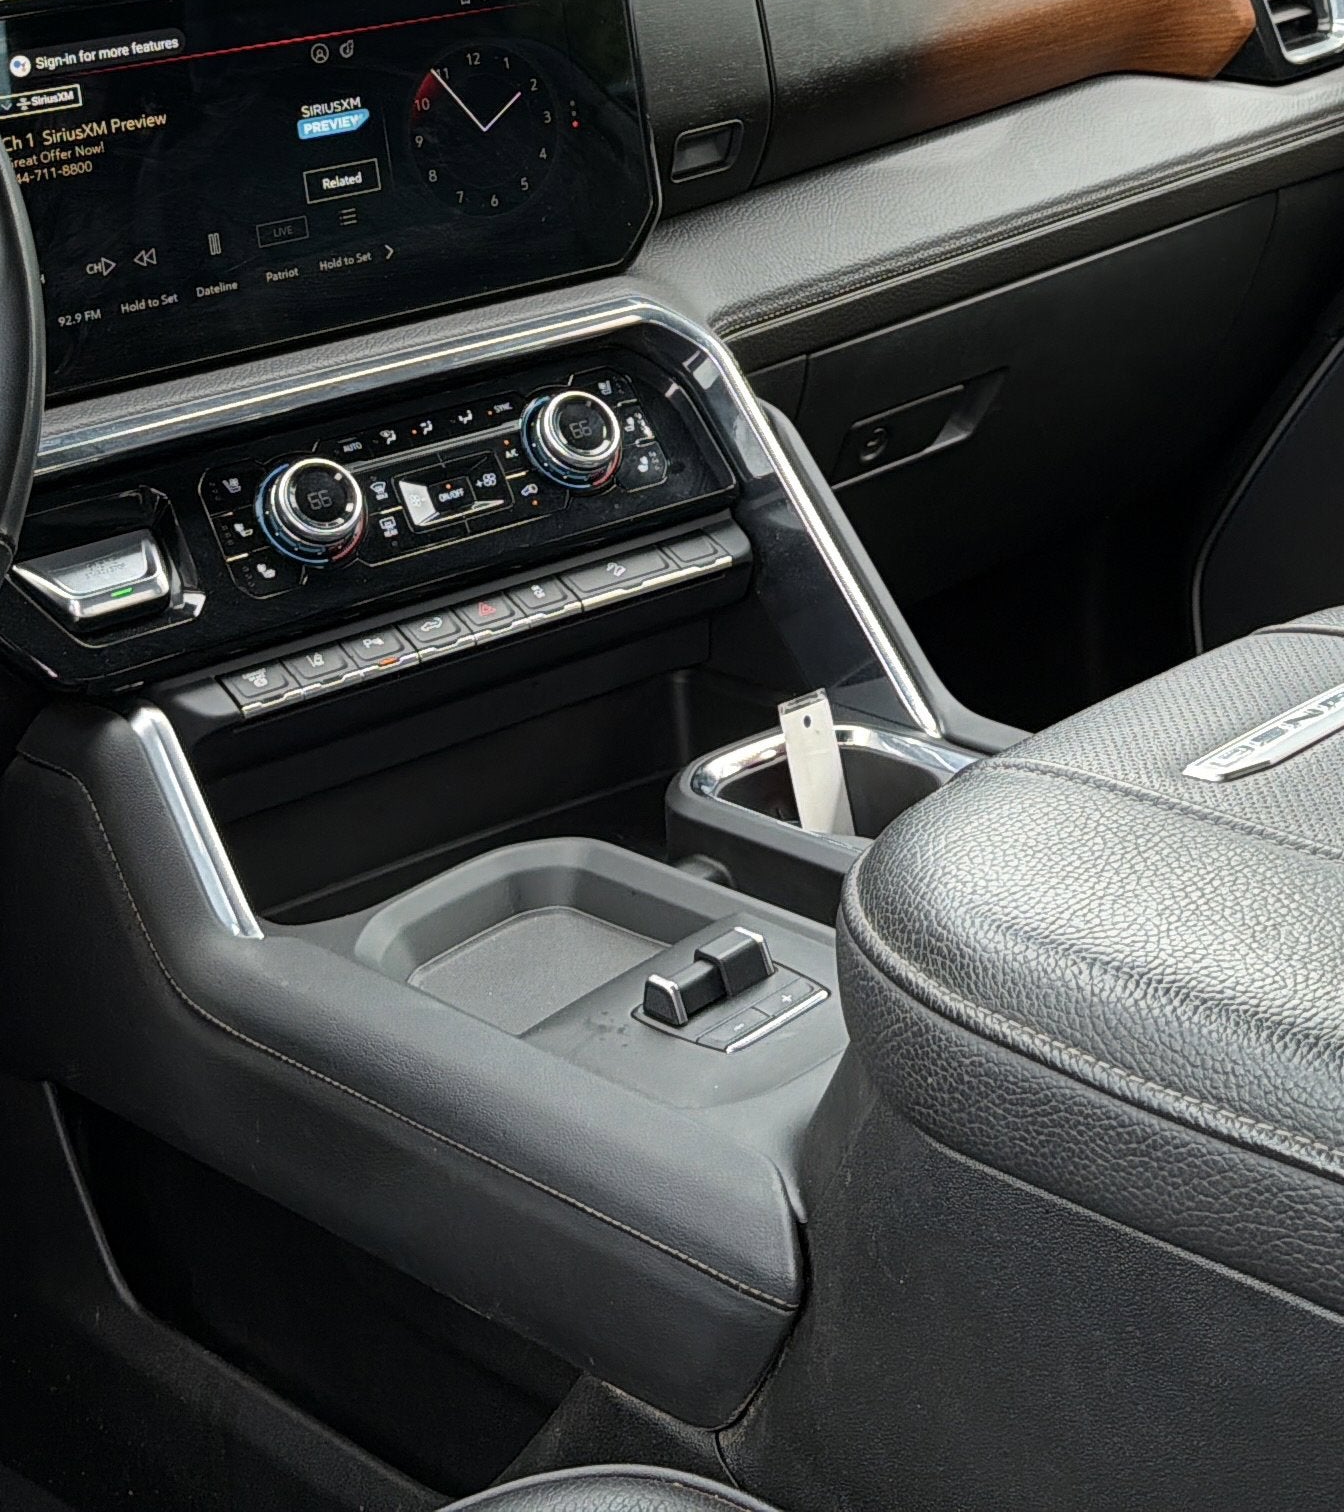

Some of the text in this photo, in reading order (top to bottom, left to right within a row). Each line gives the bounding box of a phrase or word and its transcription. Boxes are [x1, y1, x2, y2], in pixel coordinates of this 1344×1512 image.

[35, 38, 179, 71] Sign-in for more features
[465, 51, 481, 66] 12
[503, 56, 510, 70] 1
[529, 78, 538, 91] 2
[30, 90, 75, 107] SiriusXM
[414, 97, 431, 112] 10
[300, 96, 362, 118] SIRIUSXM
[303, 114, 364, 135] PREVIEW
[543, 110, 552, 124] 3
[2, 113, 167, 152] Ch 1 SiriusXM Preview
[414, 135, 424, 148] 9
[10, 141, 105, 169] reat Offer Now!
[538, 147, 547, 160] 4
[321, 171, 363, 190] Related
[428, 169, 438, 183] 8
[520, 178, 529, 191] 5
[456, 191, 464, 204] 7
[490, 194, 499, 207] 6
[272, 225, 294, 238] LIVE
[319, 251, 373, 271] Hold to Set
[265, 267, 299, 283] Patriot
[195, 280, 238, 297] Dateline
[120, 293, 179, 314] Hold to Set
[57, 308, 102, 327] 92.9 FM
[568, 419, 593, 440] 66
[342, 440, 363, 454] AUTO
[306, 488, 334, 511] 66
[437, 487, 466, 504] ON/OFF
